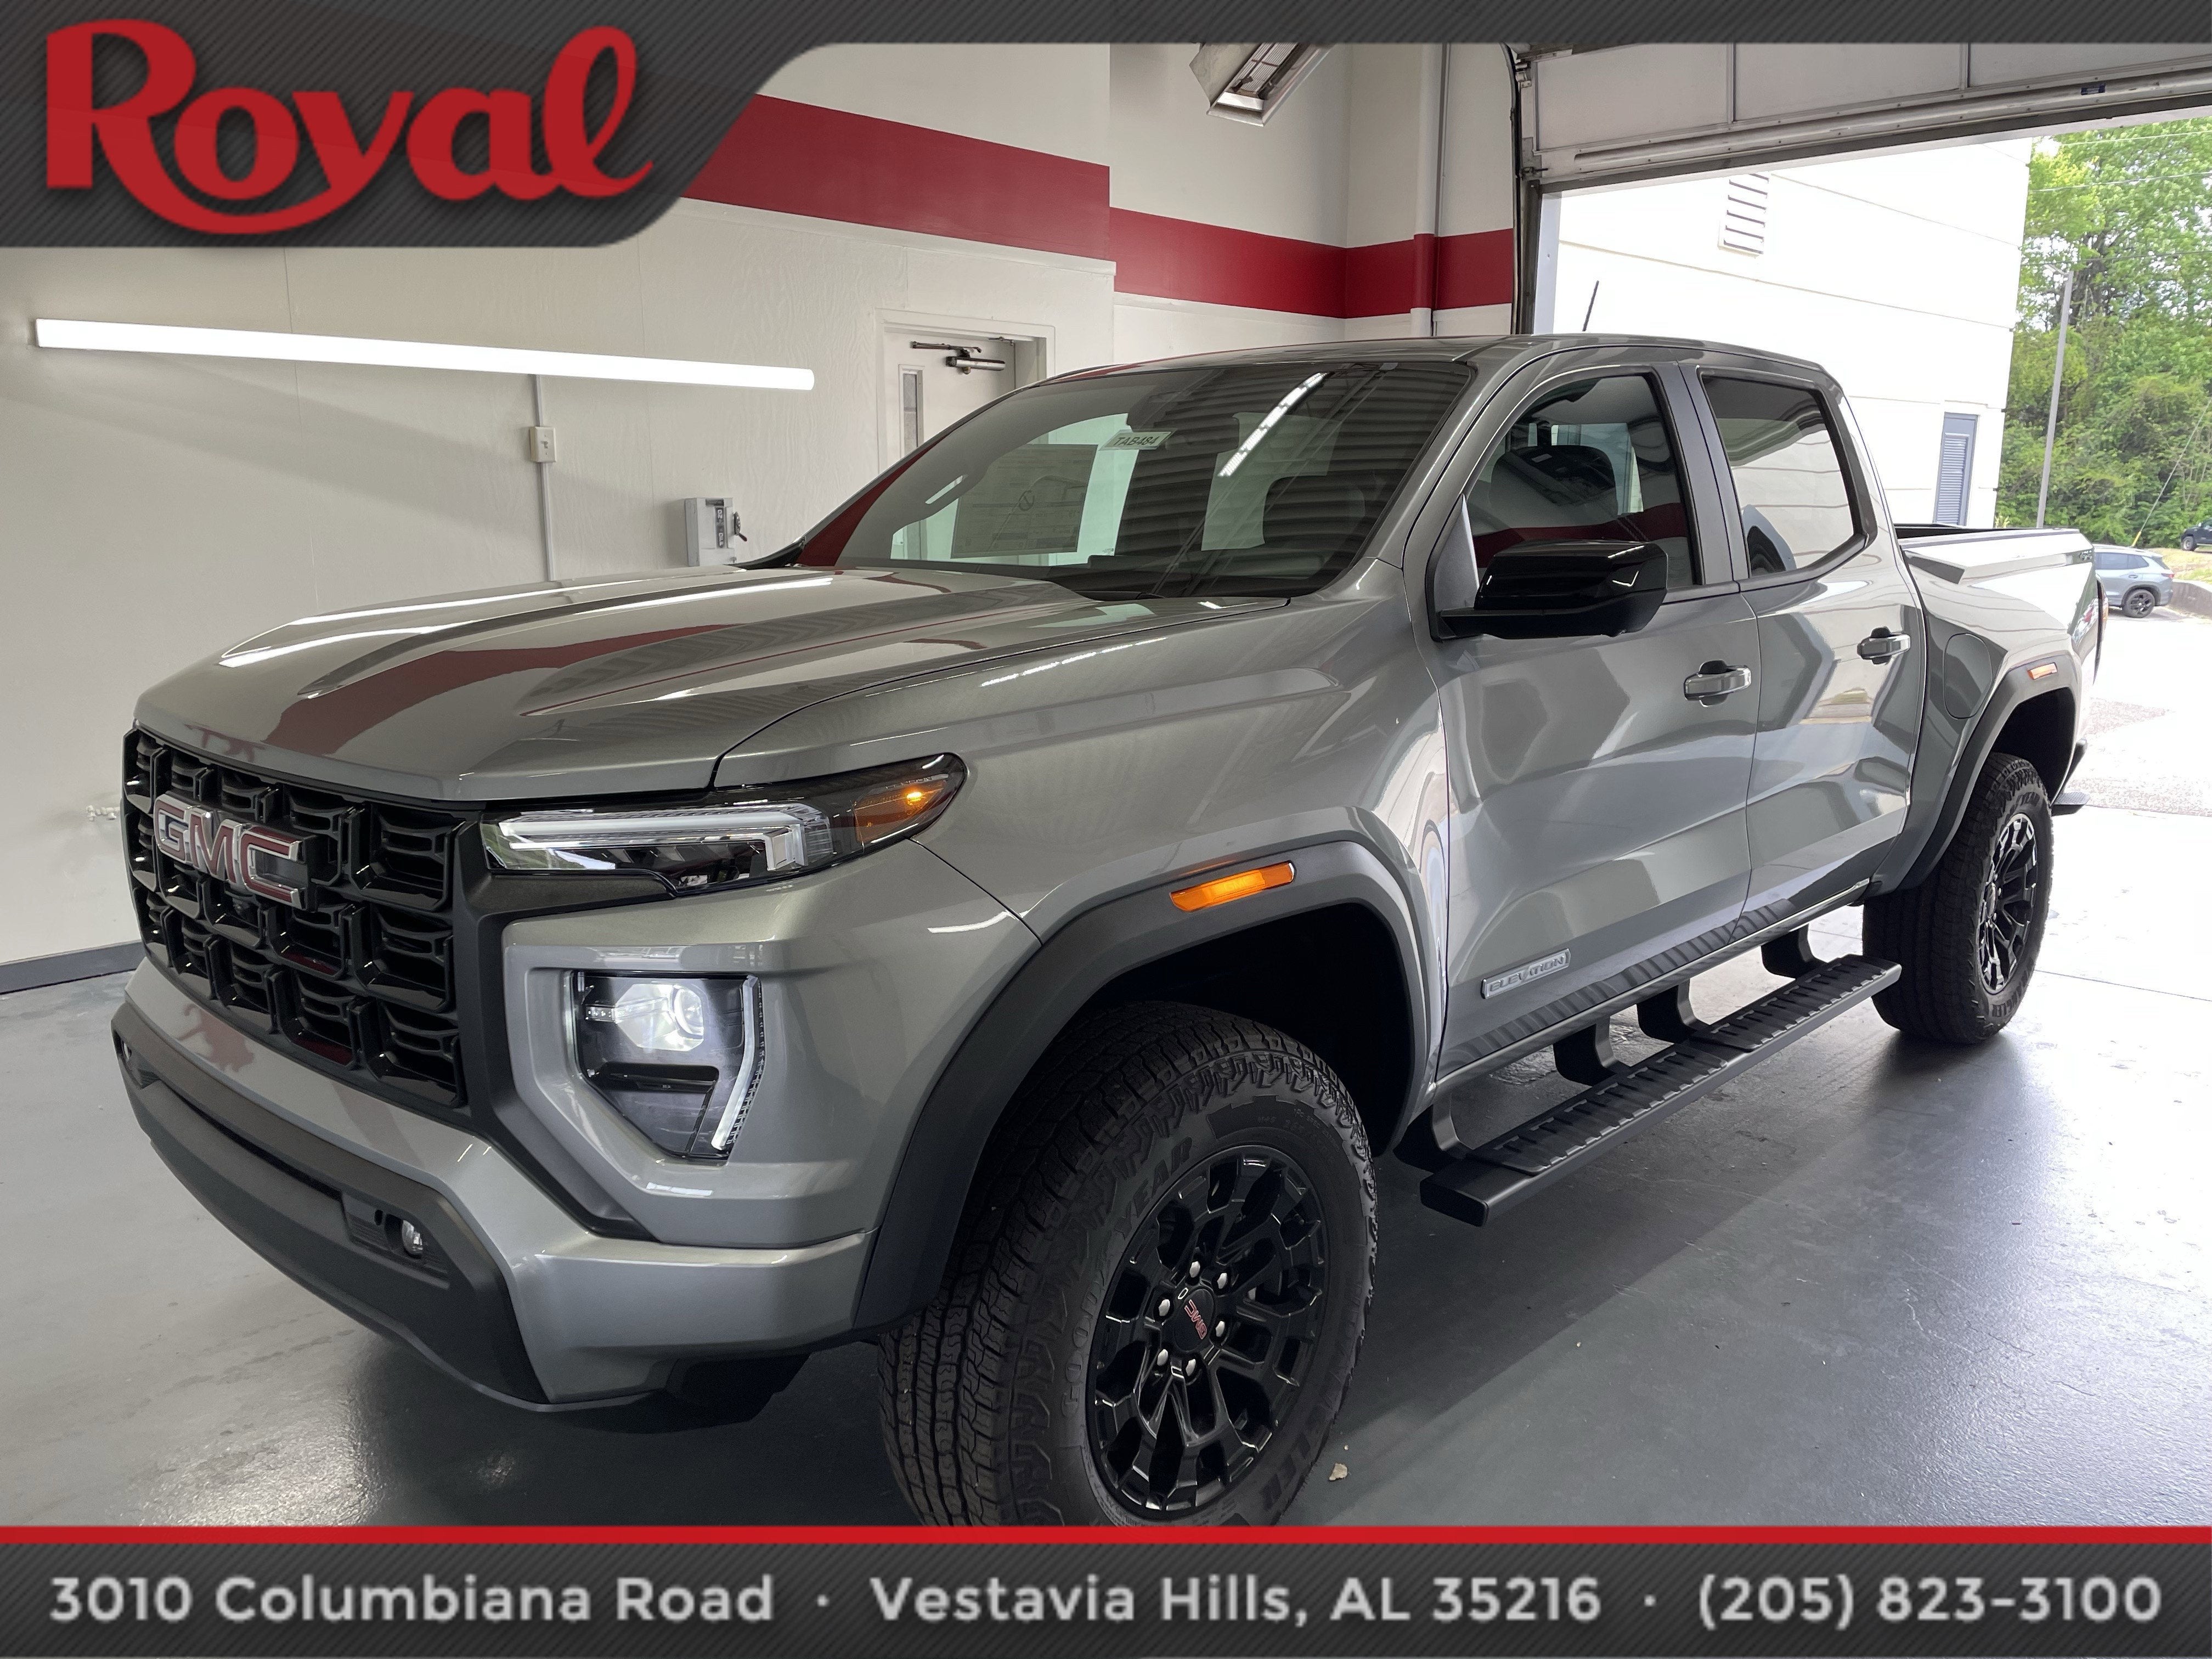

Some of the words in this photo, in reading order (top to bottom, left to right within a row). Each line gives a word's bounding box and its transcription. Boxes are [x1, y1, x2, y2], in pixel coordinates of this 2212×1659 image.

[154, 795, 308, 910] GMC
[1490, 955, 1565, 992] ELEVATION
[1184, 1299, 1207, 1340] GMC
